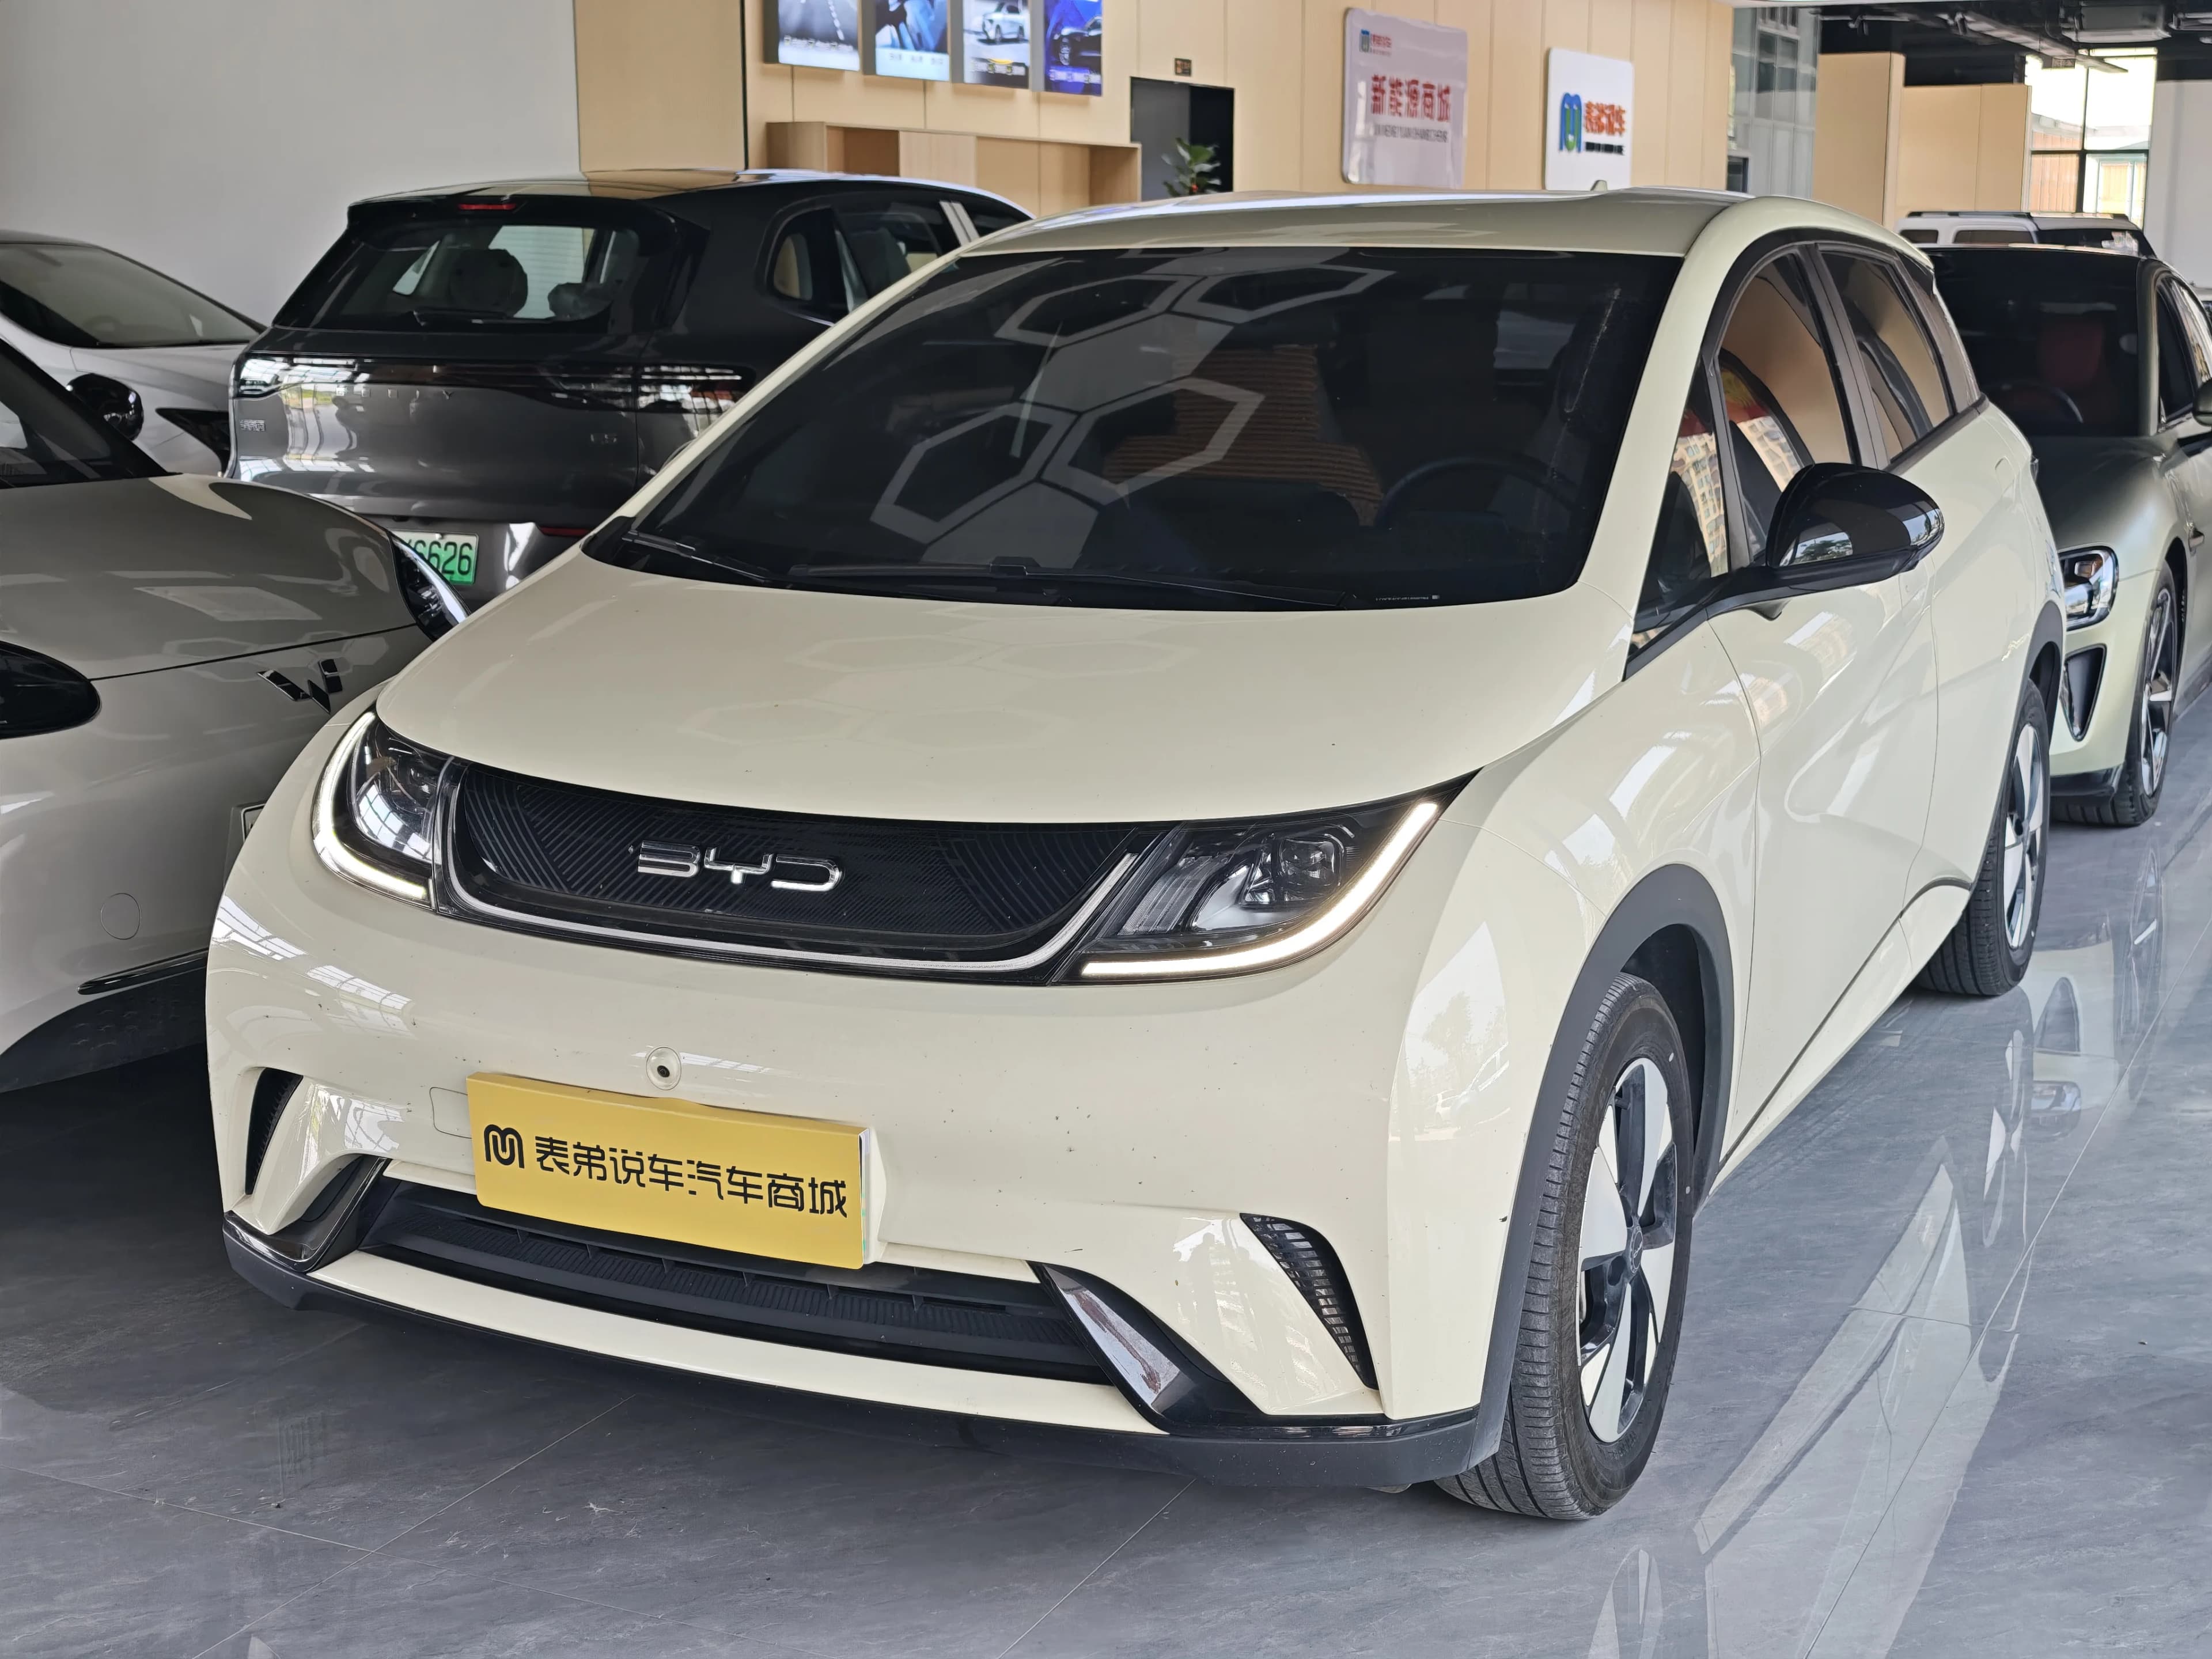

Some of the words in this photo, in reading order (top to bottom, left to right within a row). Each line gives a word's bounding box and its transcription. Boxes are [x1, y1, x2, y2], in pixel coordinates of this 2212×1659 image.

[408, 539, 473, 575] 626
[637, 840, 845, 892] BYD
[535, 1135, 848, 1218] 表弟说车汽车商城
